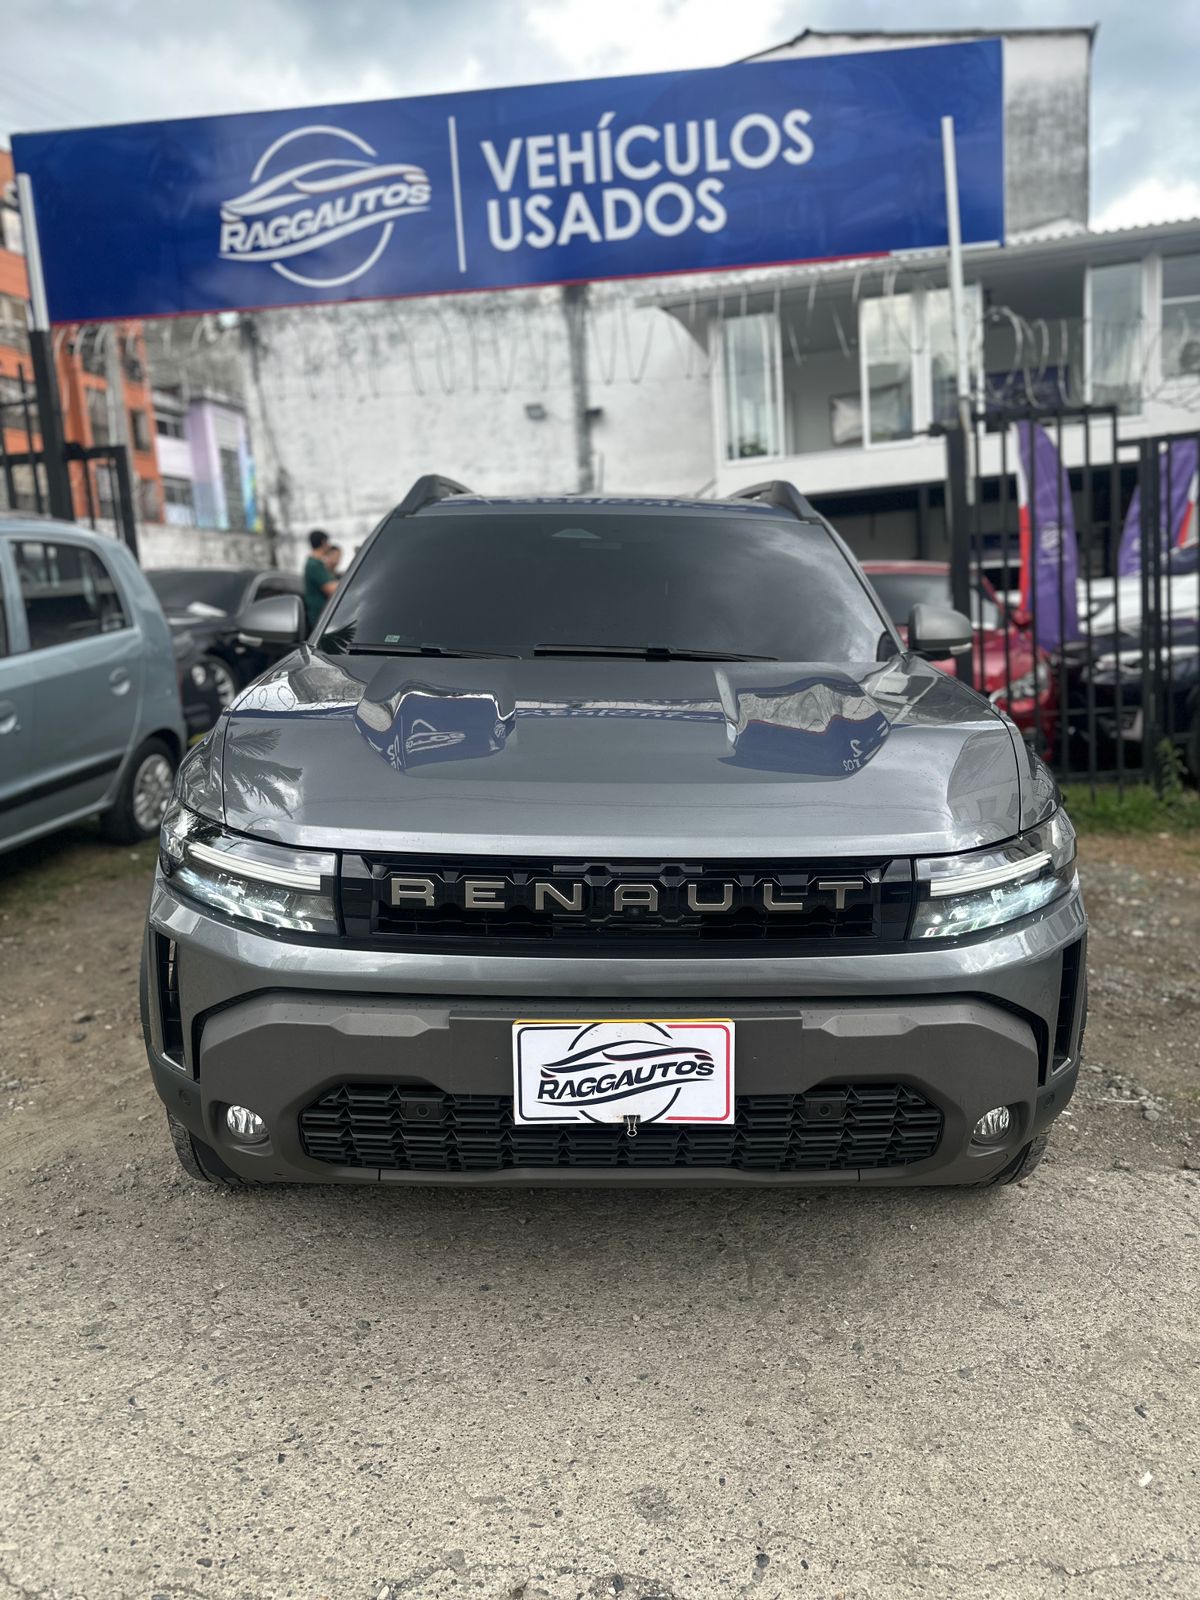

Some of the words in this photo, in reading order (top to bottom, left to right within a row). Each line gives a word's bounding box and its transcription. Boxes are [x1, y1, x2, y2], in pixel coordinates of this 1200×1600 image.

[480, 110, 814, 192] VEHÍCULOS
[220, 183, 431, 252] RAGGAUTOS
[487, 178, 727, 251] USADOS
[391, 878, 863, 912] RENAULT
[537, 1060, 714, 1100] RAGGAUTOS
